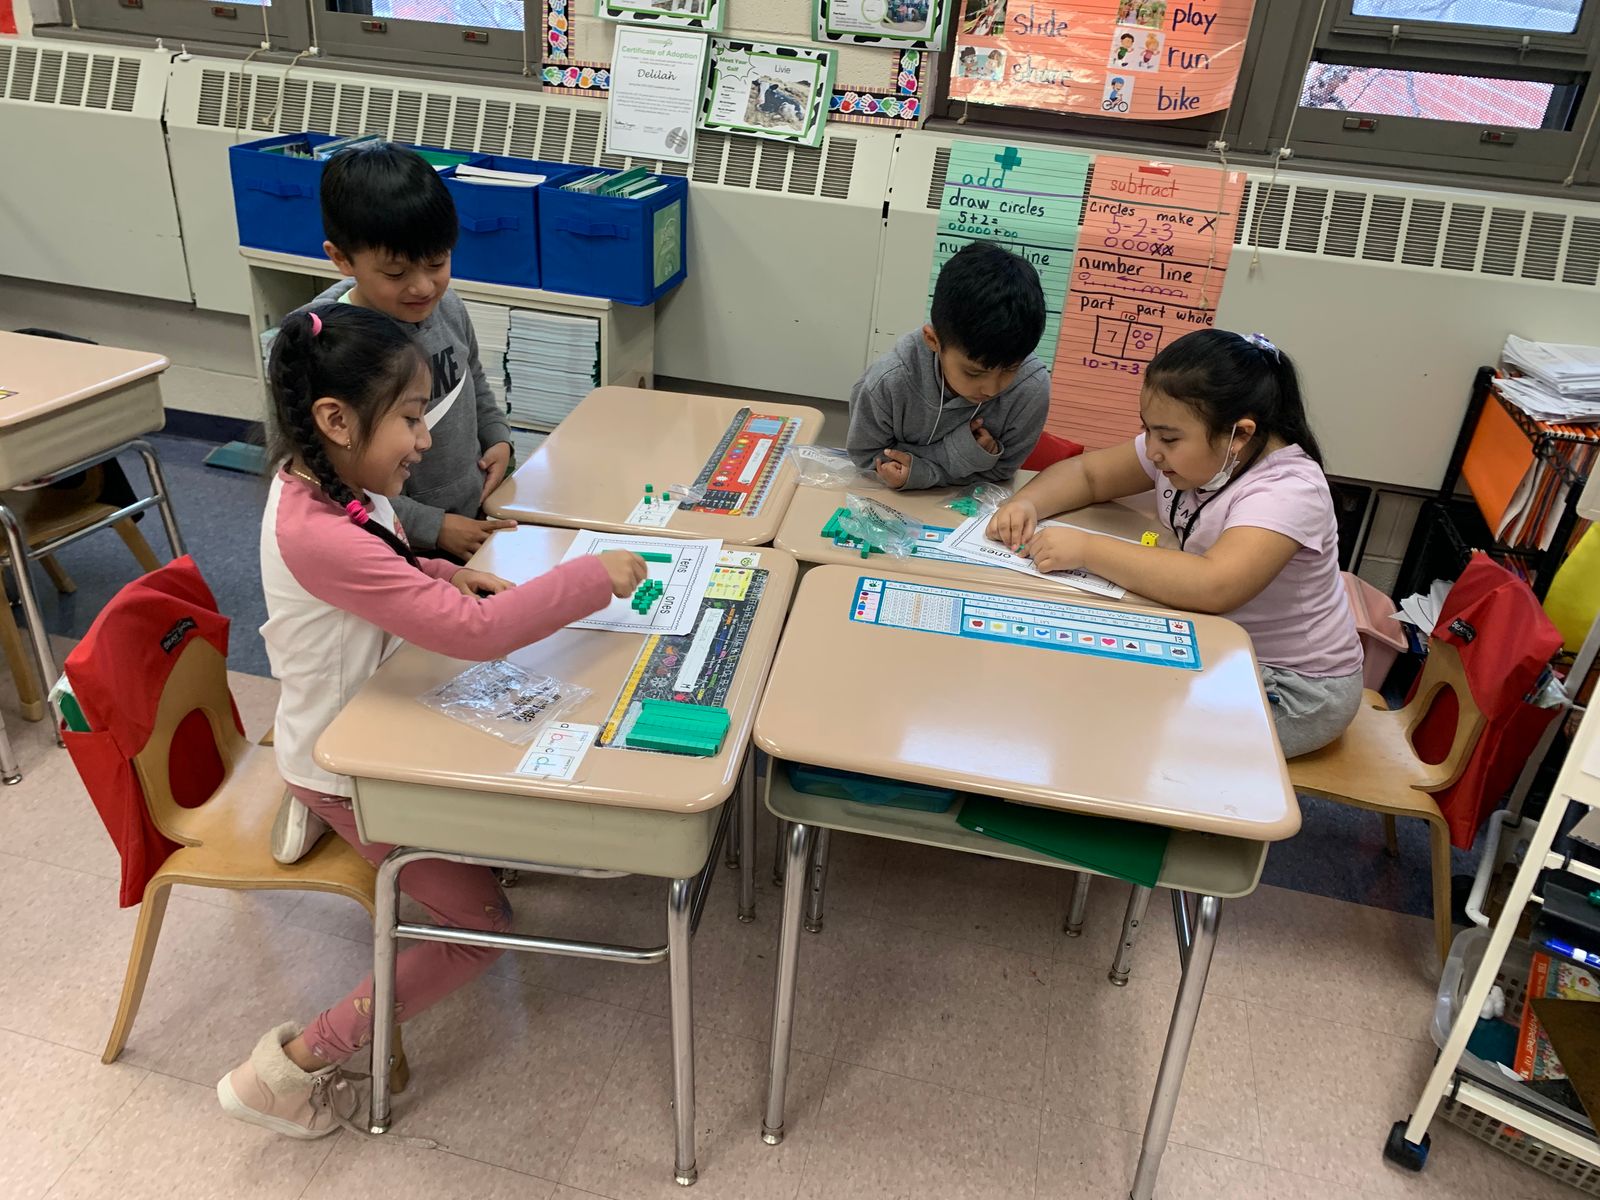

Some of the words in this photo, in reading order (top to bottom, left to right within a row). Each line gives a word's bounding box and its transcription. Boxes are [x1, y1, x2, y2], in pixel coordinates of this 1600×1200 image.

[1013, 4, 1069, 37] slide
[1172, 2, 1218, 35] play
[621, 45, 656, 56] Certificate
[666, 50, 698, 60] Adoption
[1167, 46, 1210, 70] run
[637, 68, 677, 80] Delilah
[774, 64, 792, 74] Livie
[1157, 85, 1200, 111] bike
[962, 167, 1006, 189] add
[1110, 172, 1180, 198] subtract
[948, 187, 990, 210] draw
[999, 196, 1045, 217] circles
[1156, 212, 1194, 226] make
[1079, 256, 1145, 276] number
[1160, 261, 1193, 283] line
[1080, 295, 1115, 311] part
[1136, 304, 1166, 318] part
[1176, 309, 1214, 326] whole
[1107, 330, 1118, 343] 7
[979, 547, 1012, 559] ones
[677, 558, 693, 574] tens
[660, 595, 676, 615] ones
[1174, 635, 1184, 644] 13
